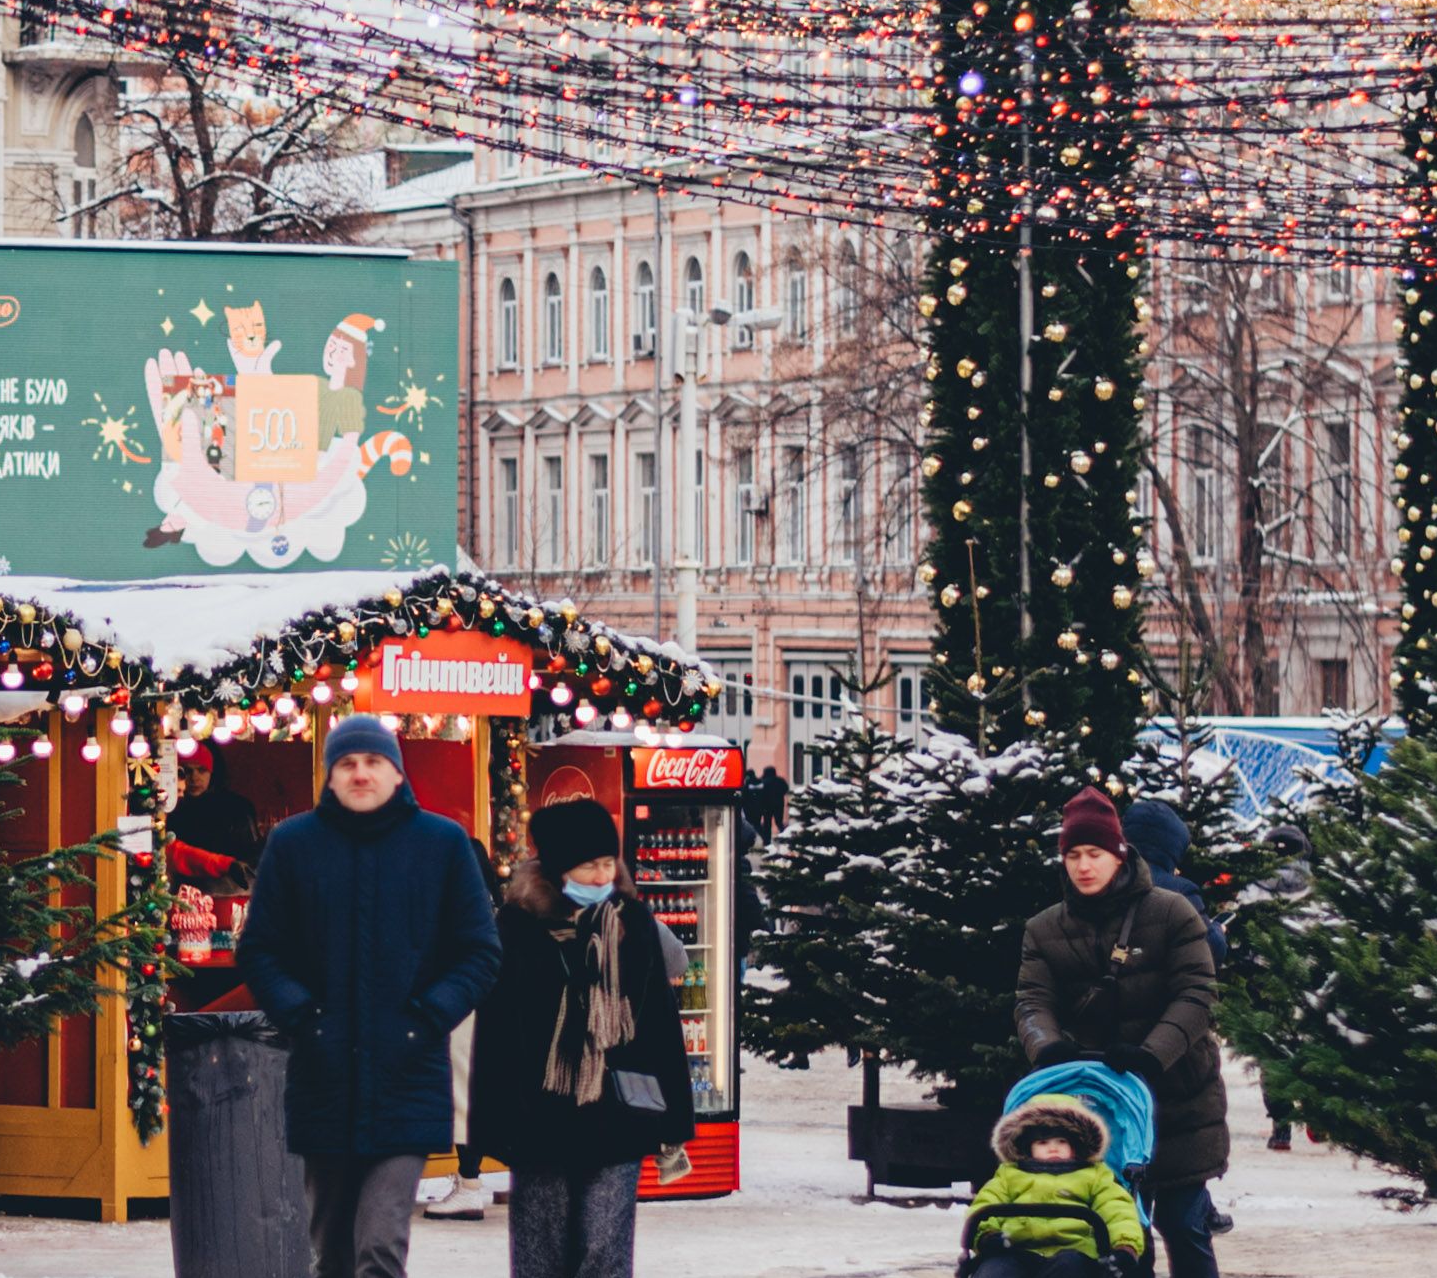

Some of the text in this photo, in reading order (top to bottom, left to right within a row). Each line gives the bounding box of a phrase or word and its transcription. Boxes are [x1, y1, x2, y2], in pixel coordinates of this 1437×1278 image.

[0, 377, 20, 404] НЕ
[25, 378, 69, 405] БУЛО
[248, 408, 297, 453] 500
[381, 644, 525, 698] Глінтвейн
[646, 748, 729, 787] Coca-Cola
